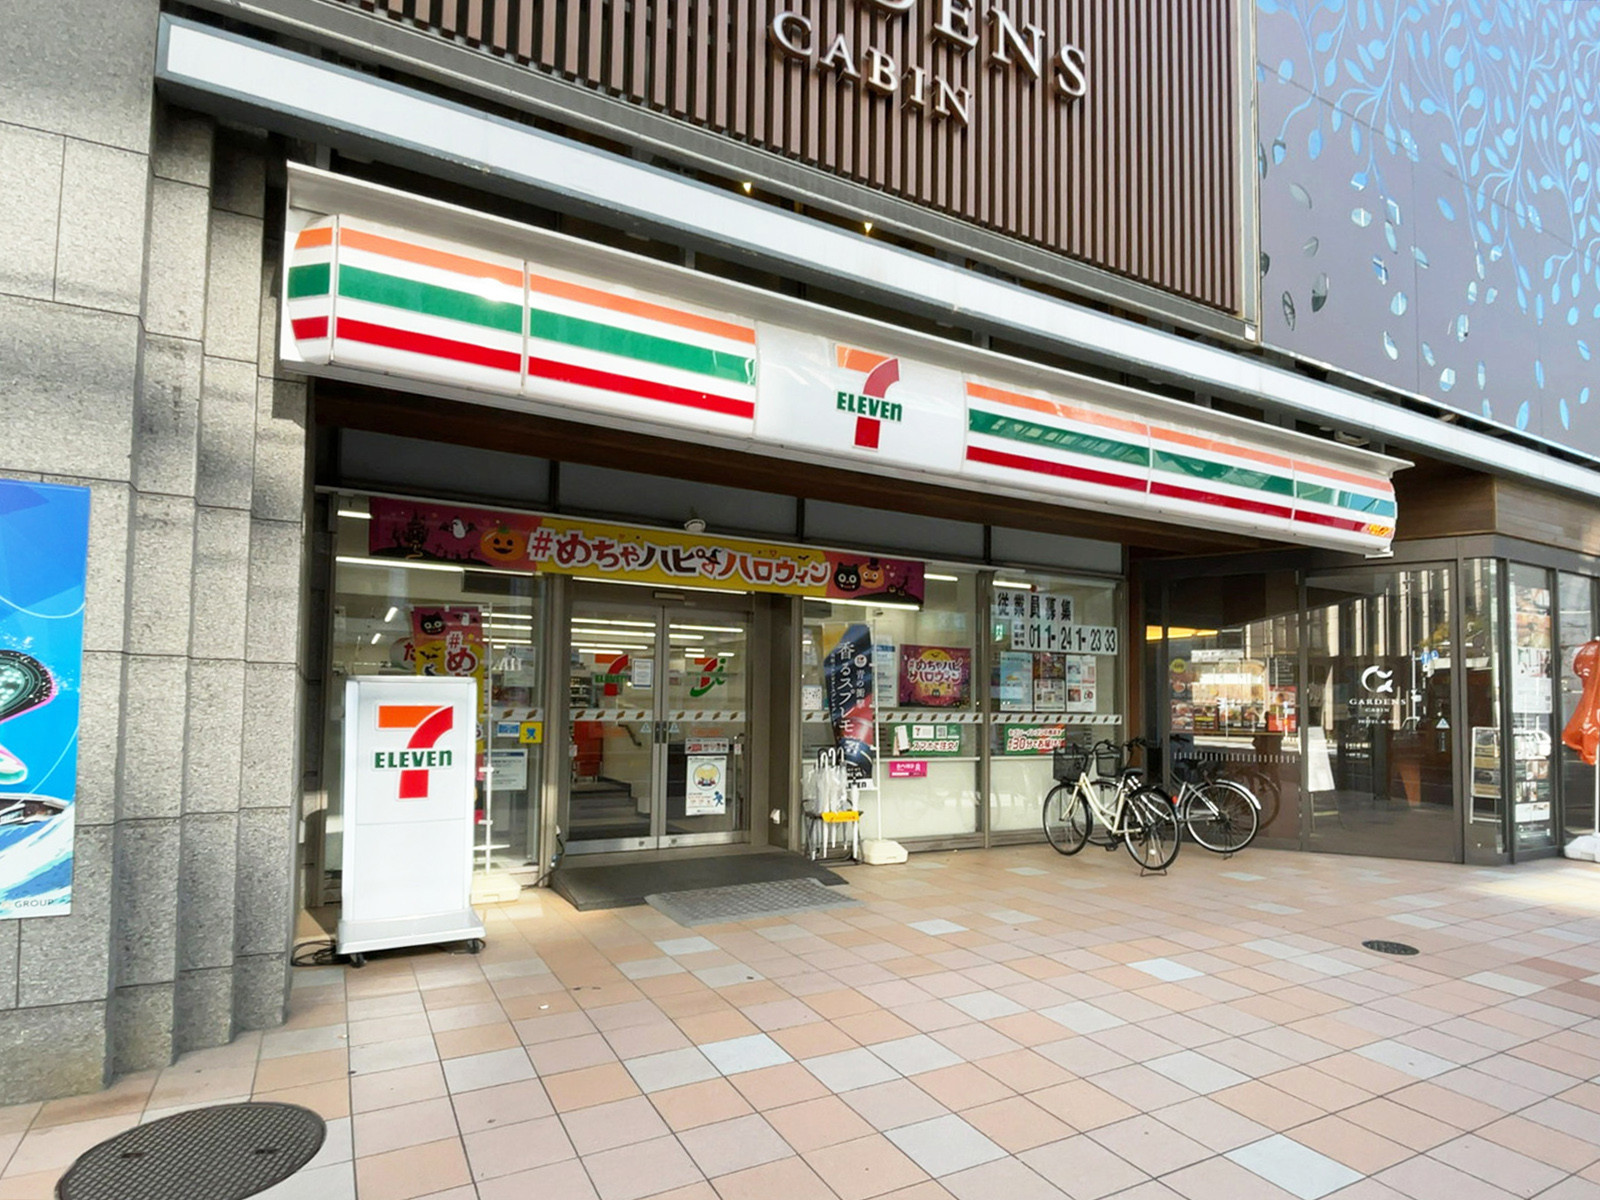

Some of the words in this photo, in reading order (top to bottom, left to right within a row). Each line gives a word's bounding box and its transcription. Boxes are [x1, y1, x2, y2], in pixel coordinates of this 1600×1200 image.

[866, 0, 1087, 98] ENS
[769, 11, 972, 127] CABIN
[997, 592, 1072, 622] 従業員募集
[1349, 698, 1407, 706] GARDENS
[14, 898, 55, 908] GROUP
